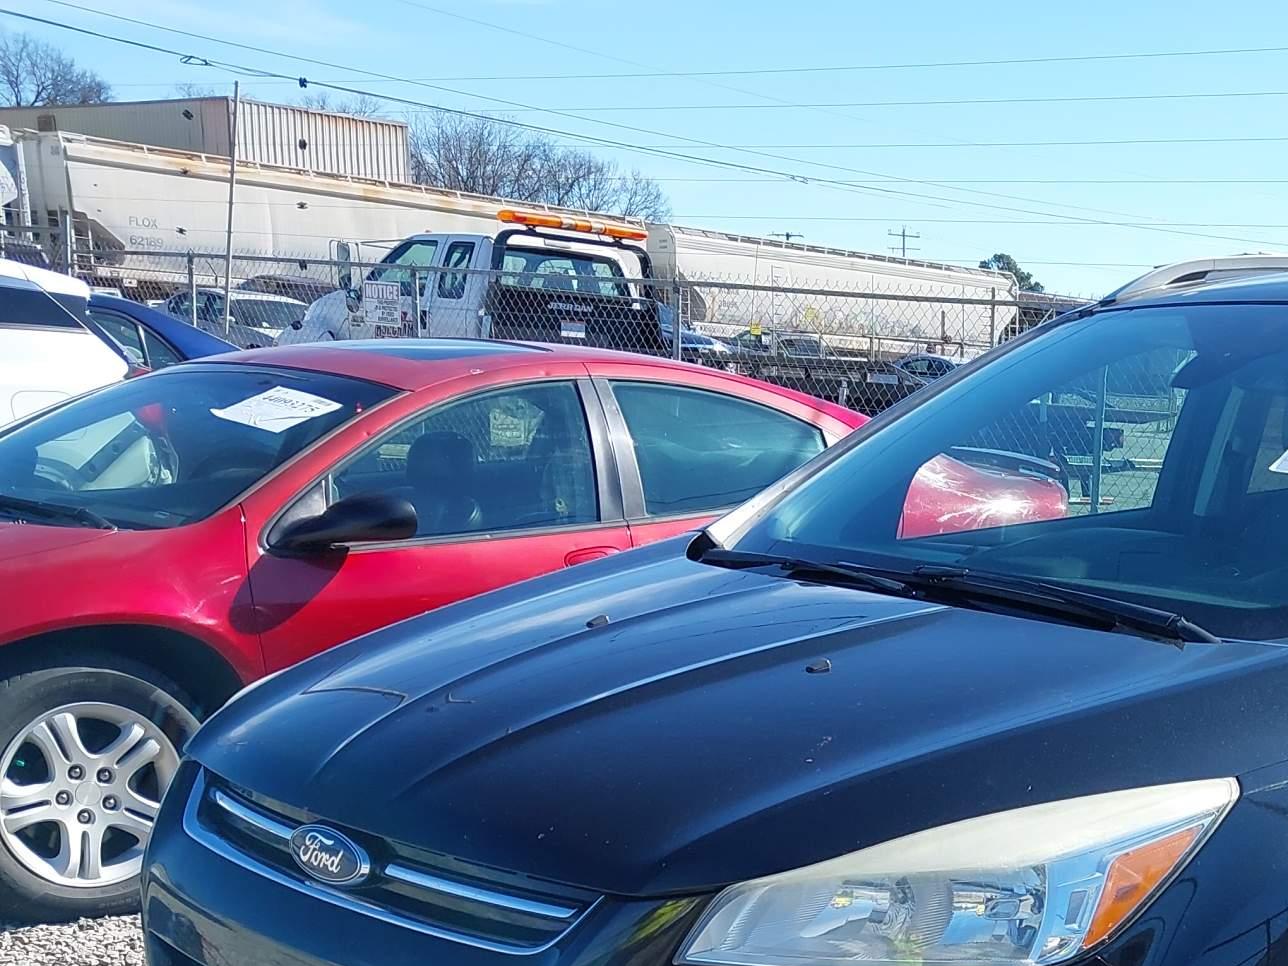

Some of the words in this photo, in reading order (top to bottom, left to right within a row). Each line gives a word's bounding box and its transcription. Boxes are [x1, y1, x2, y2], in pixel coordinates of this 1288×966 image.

[129, 216, 158, 229] FLOX
[365, 284, 399, 300] NOTICE
[300, 831, 343, 873] Ford
